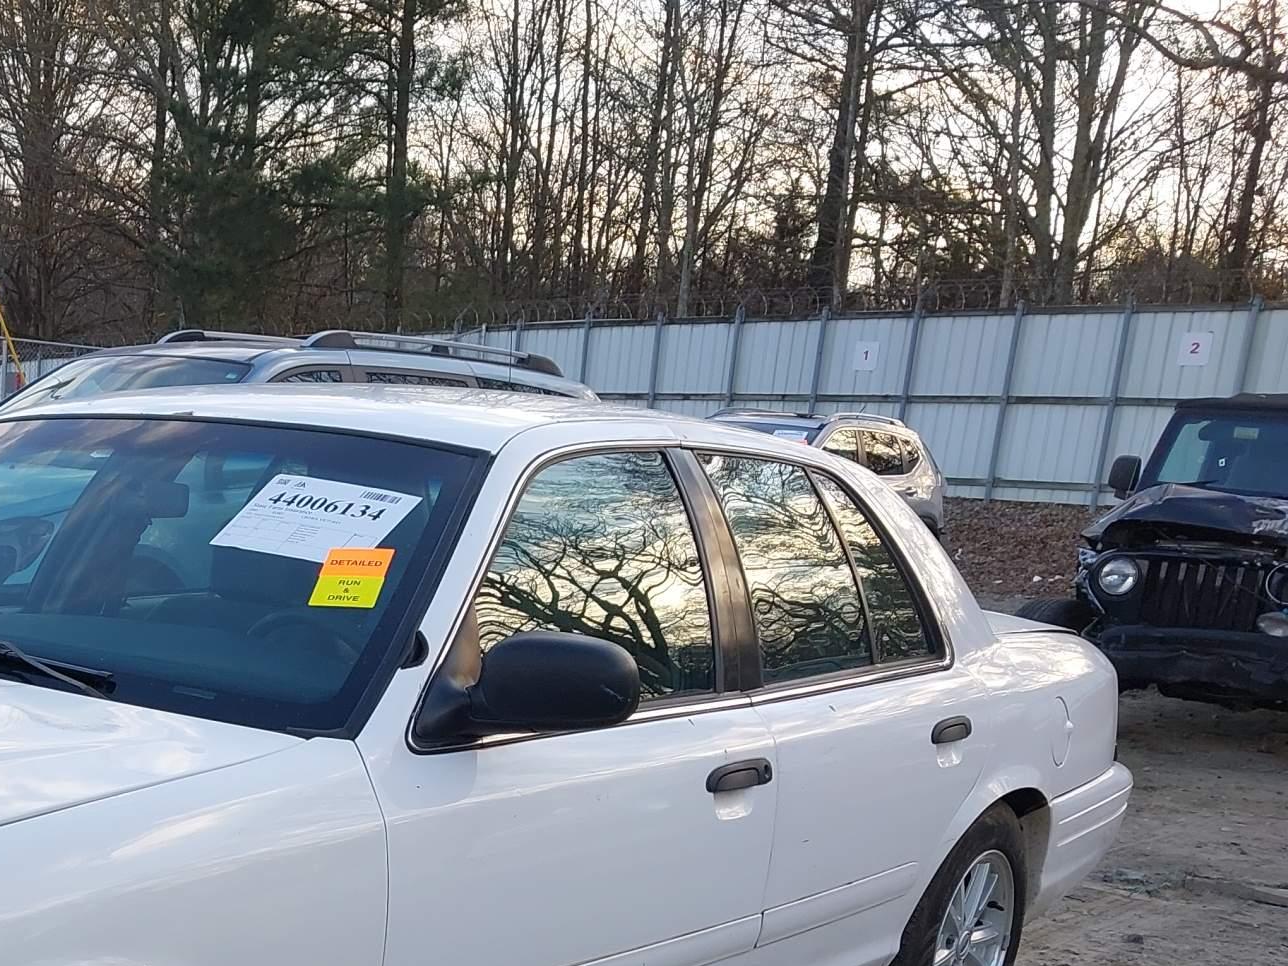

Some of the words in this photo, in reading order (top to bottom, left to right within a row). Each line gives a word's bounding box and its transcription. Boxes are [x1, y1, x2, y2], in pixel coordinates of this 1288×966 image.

[1190, 342, 1201, 354] 2
[863, 350, 870, 361] 1
[268, 491, 387, 520] 44006134
[330, 559, 383, 567] DETAILED
[327, 594, 360, 602] DRIVE
